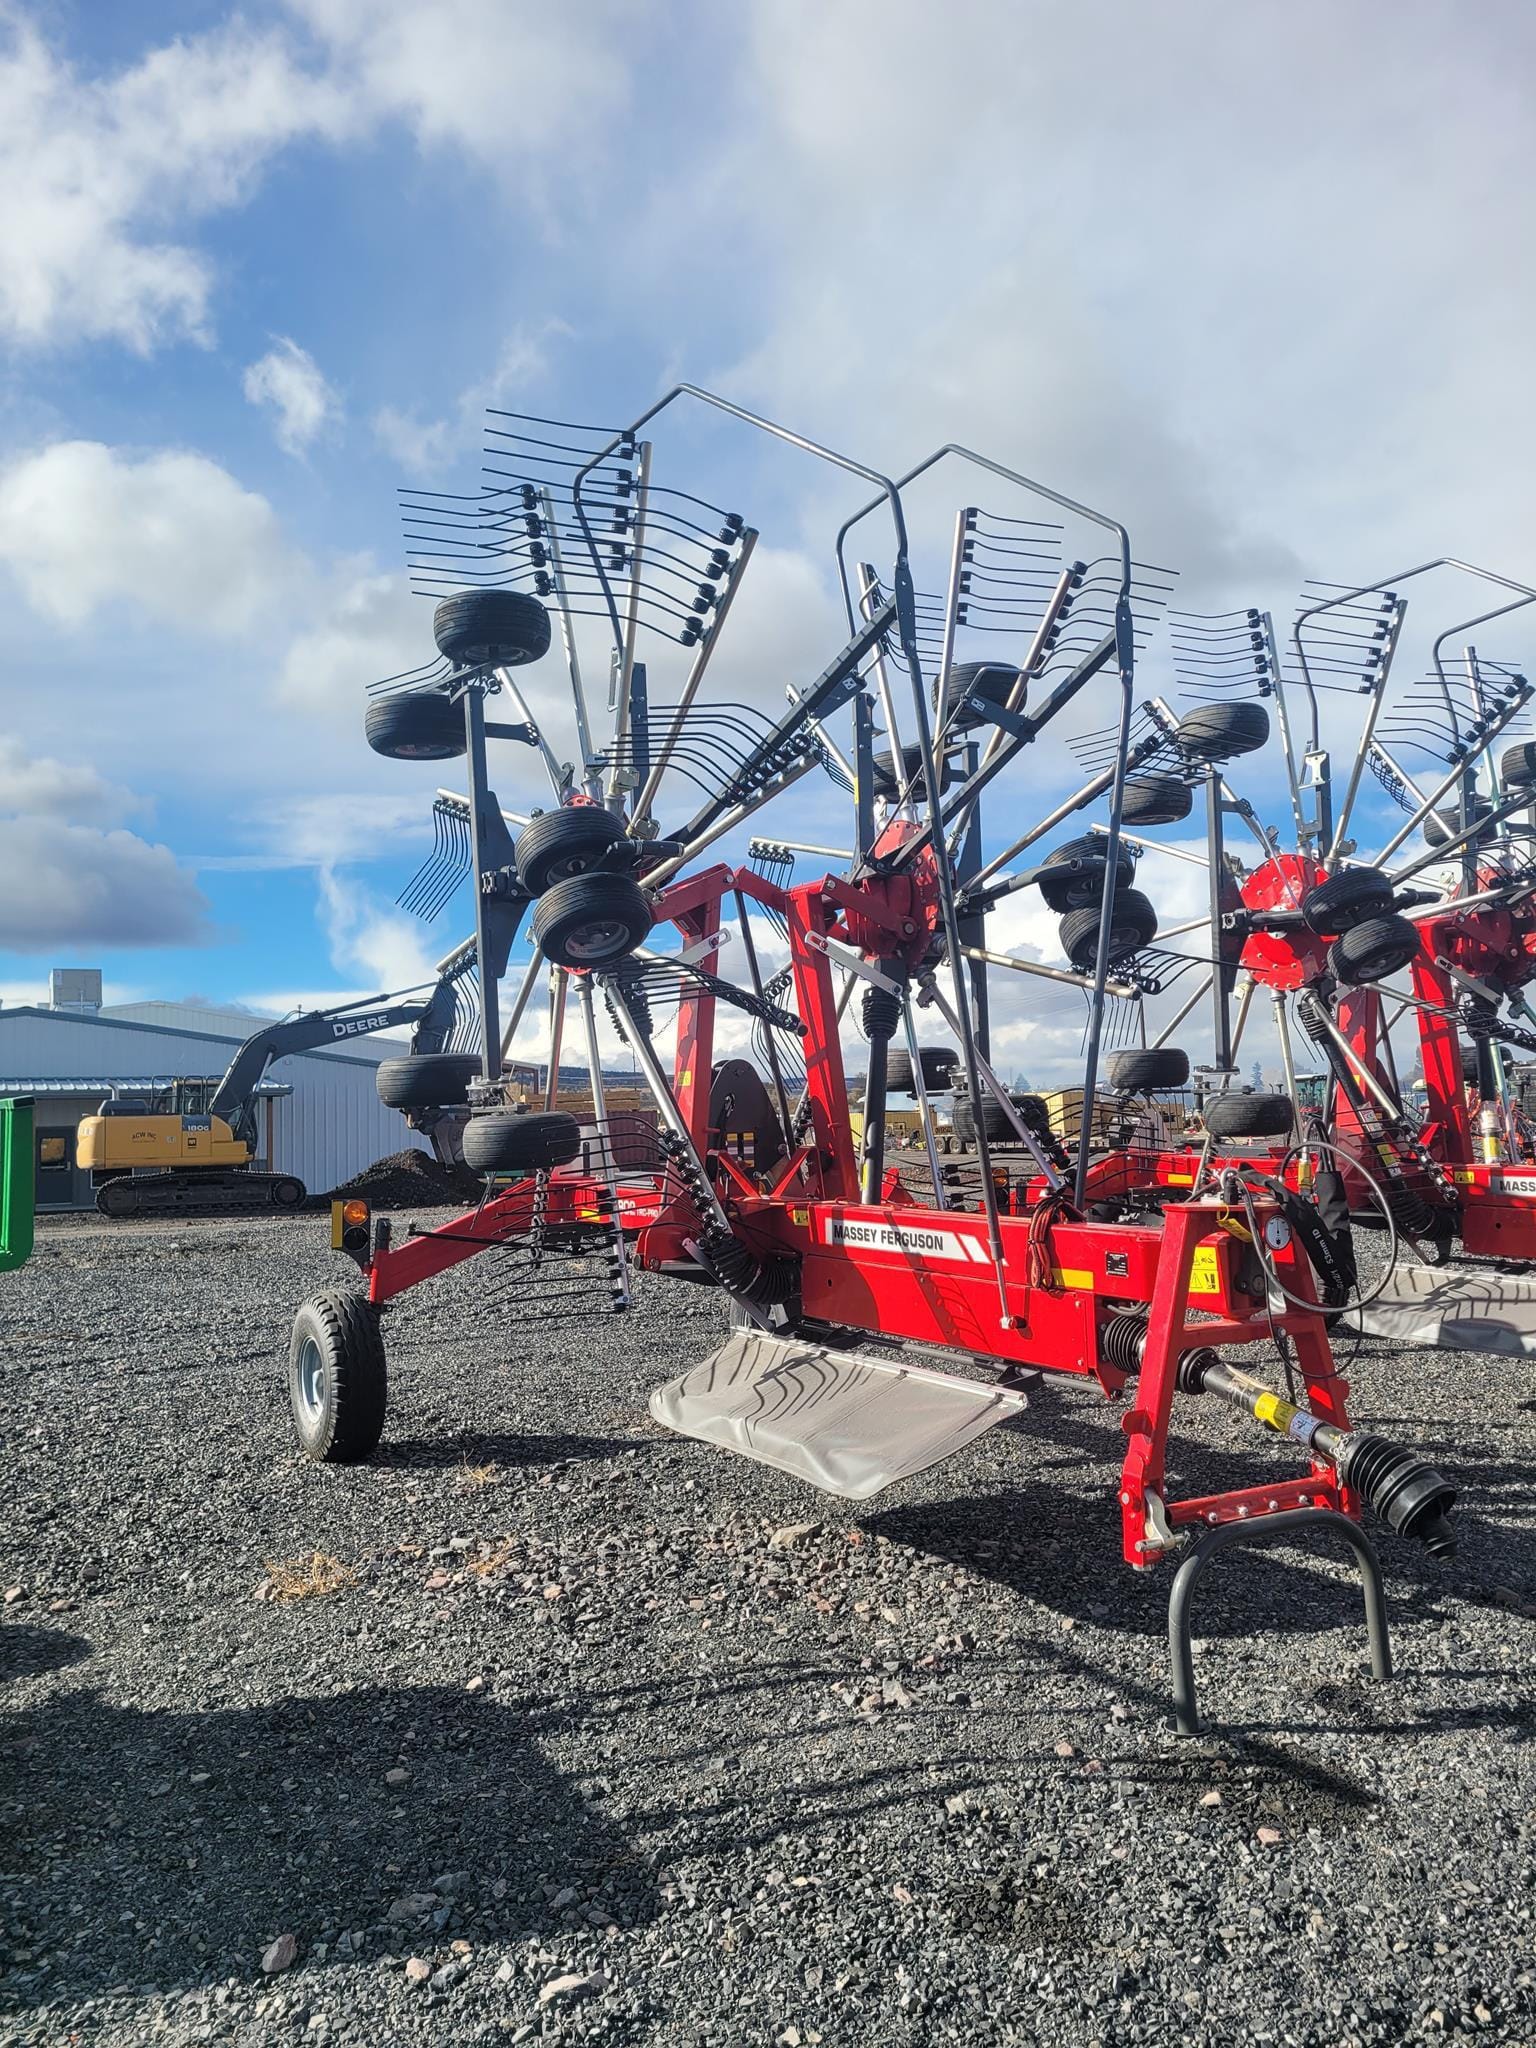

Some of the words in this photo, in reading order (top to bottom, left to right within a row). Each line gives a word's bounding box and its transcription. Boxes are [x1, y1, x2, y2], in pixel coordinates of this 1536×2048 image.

[332, 1015, 390, 1037] DEERE
[834, 1225, 877, 1244] MASSEY
[880, 1229, 944, 1251] FERGUSON
[1312, 1228, 1322, 1239] ID
[1320, 1239, 1334, 1265] 53mm
